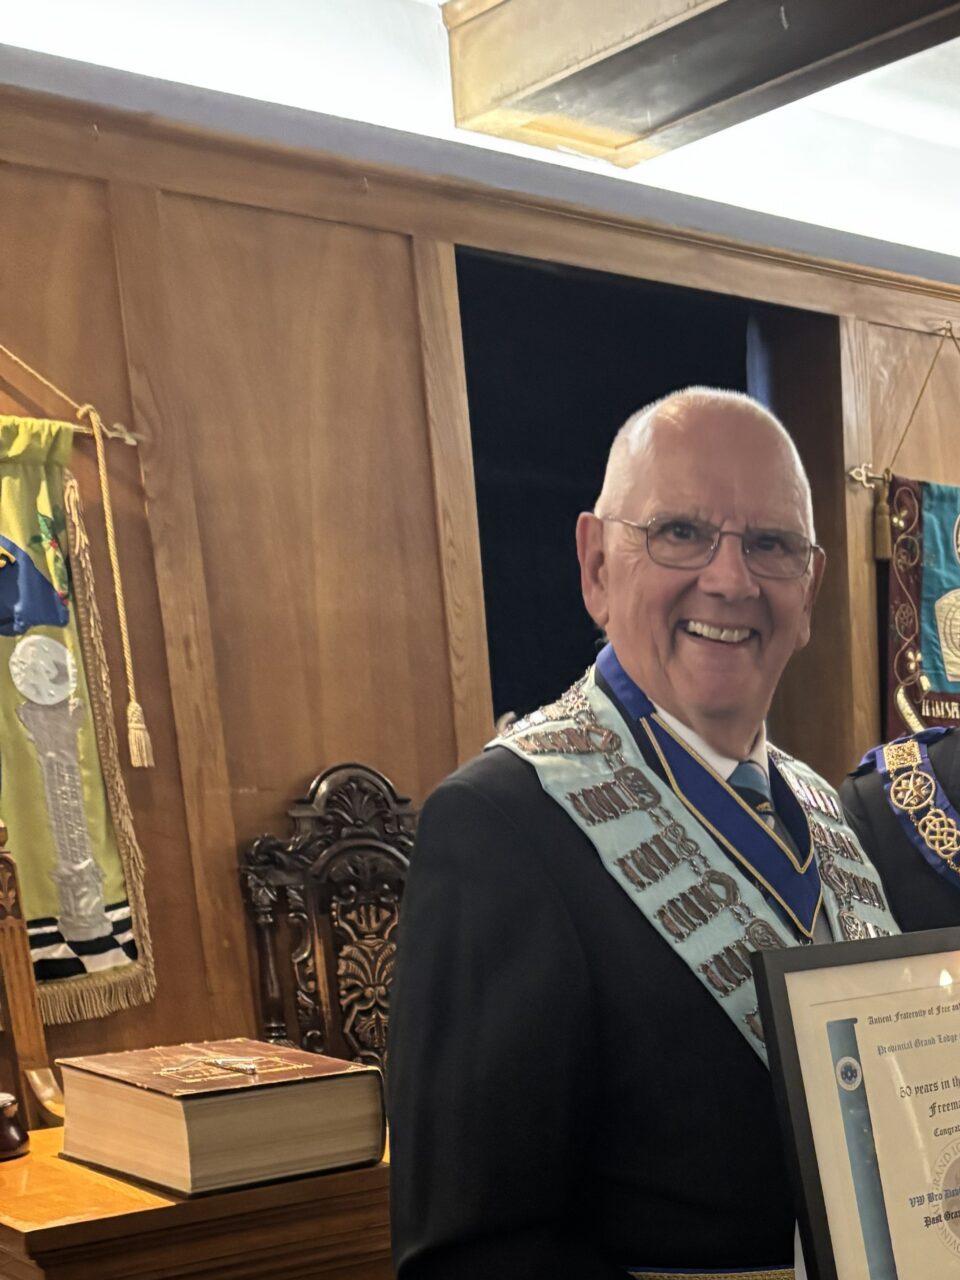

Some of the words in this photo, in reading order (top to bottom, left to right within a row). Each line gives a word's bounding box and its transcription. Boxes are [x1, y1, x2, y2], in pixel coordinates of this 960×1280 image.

[894, 1009, 927, 1023] Fraternity
[928, 1007, 934, 1016] of
[936, 1004, 951, 1015] Free
[877, 1041, 913, 1056] Provincial
[914, 1037, 936, 1049] Grand
[936, 1033, 958, 1044] Lodge
[900, 1085, 912, 1099] 50
[914, 1082, 939, 1096] years
[941, 1079, 950, 1090] in
[927, 1191, 943, 1203] Bro
[923, 1214, 943, 1228] Past
